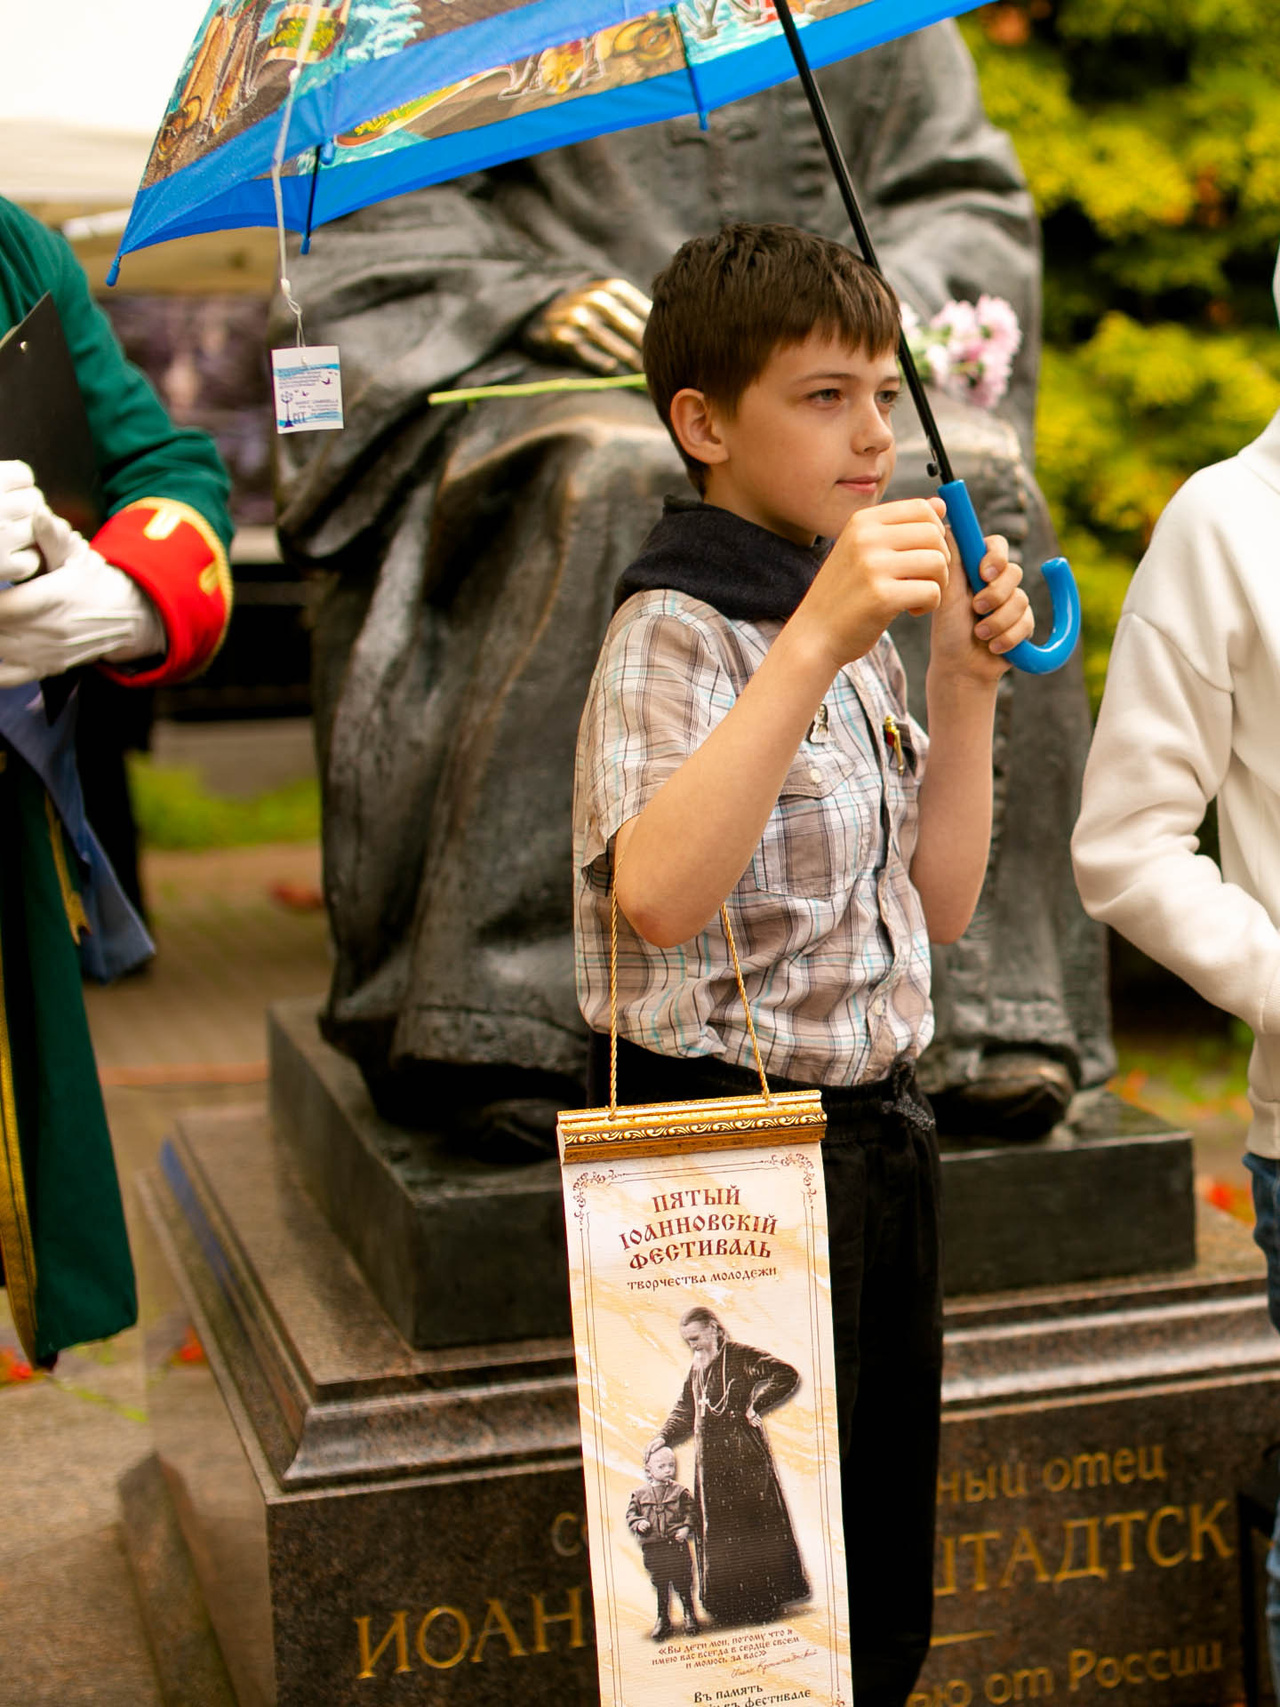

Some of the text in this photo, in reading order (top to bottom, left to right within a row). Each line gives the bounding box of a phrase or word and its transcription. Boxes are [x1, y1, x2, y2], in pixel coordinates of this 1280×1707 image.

[652, 1184, 741, 1214] ПЯТЫЙ
[629, 1238, 772, 1271] ФЕСТИВАЛЬ
[933, 1500, 1236, 1597] ТАДТСК
[353, 1586, 587, 1680] ИОАН
